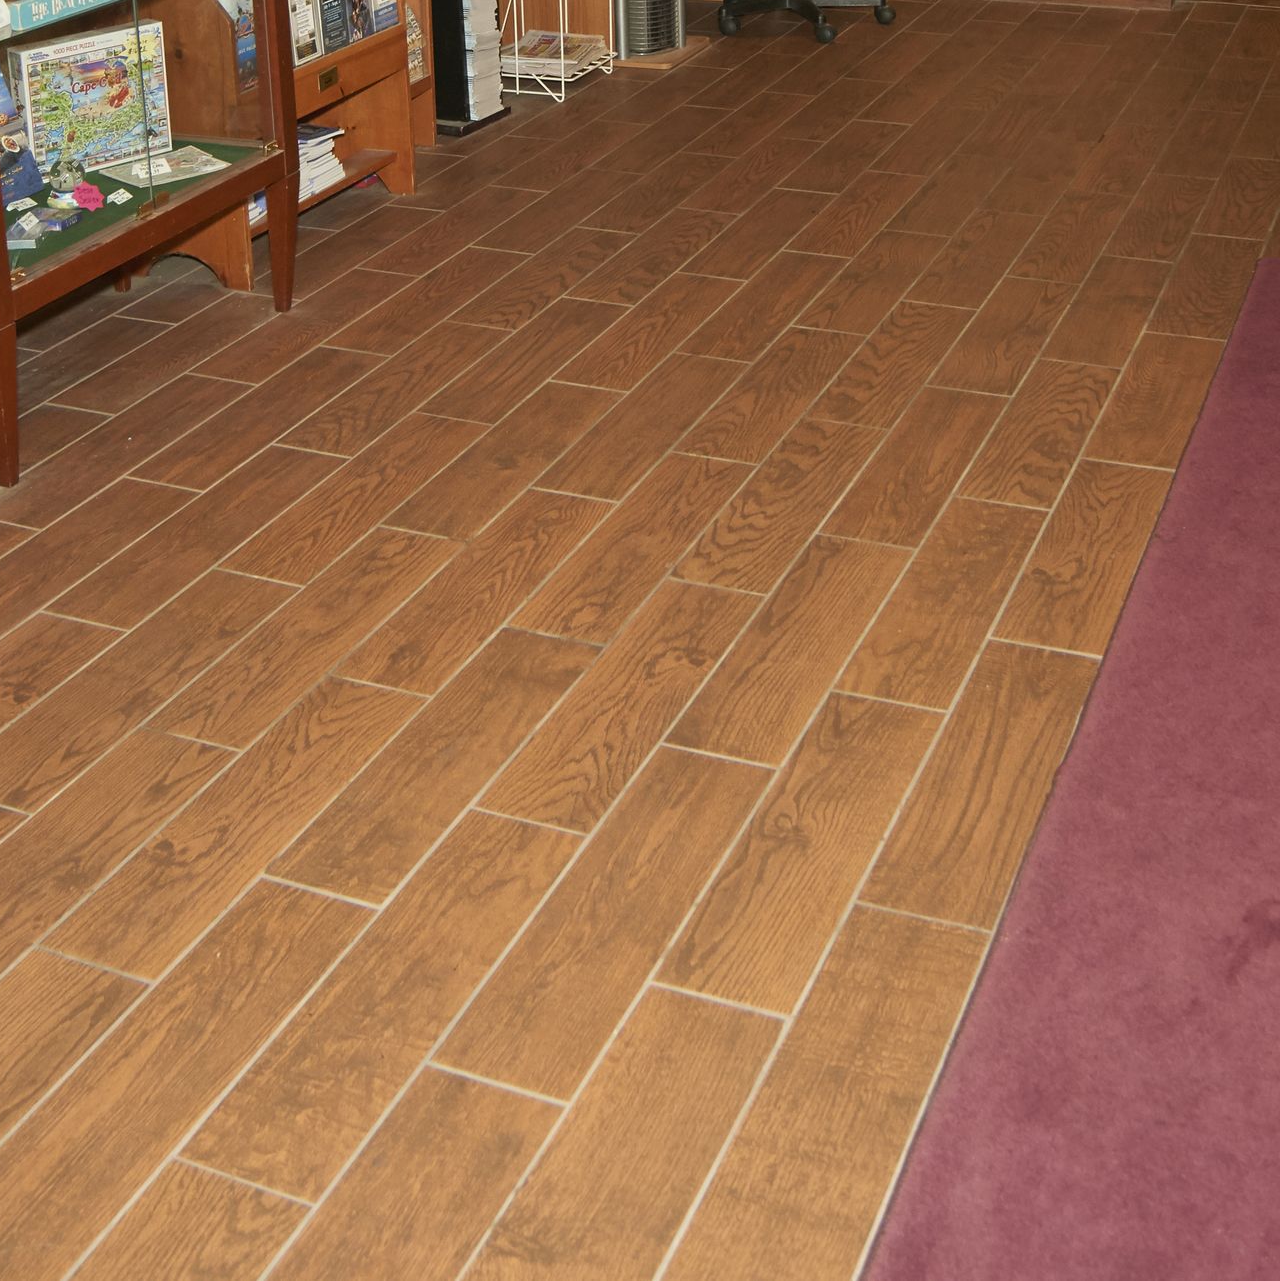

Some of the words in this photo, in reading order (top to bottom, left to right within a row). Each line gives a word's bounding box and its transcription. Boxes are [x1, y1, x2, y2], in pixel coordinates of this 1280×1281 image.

[30, 1, 49, 21] THE
[80, 42, 96, 50] PUZZLE
[71, 80, 97, 95] Cape
